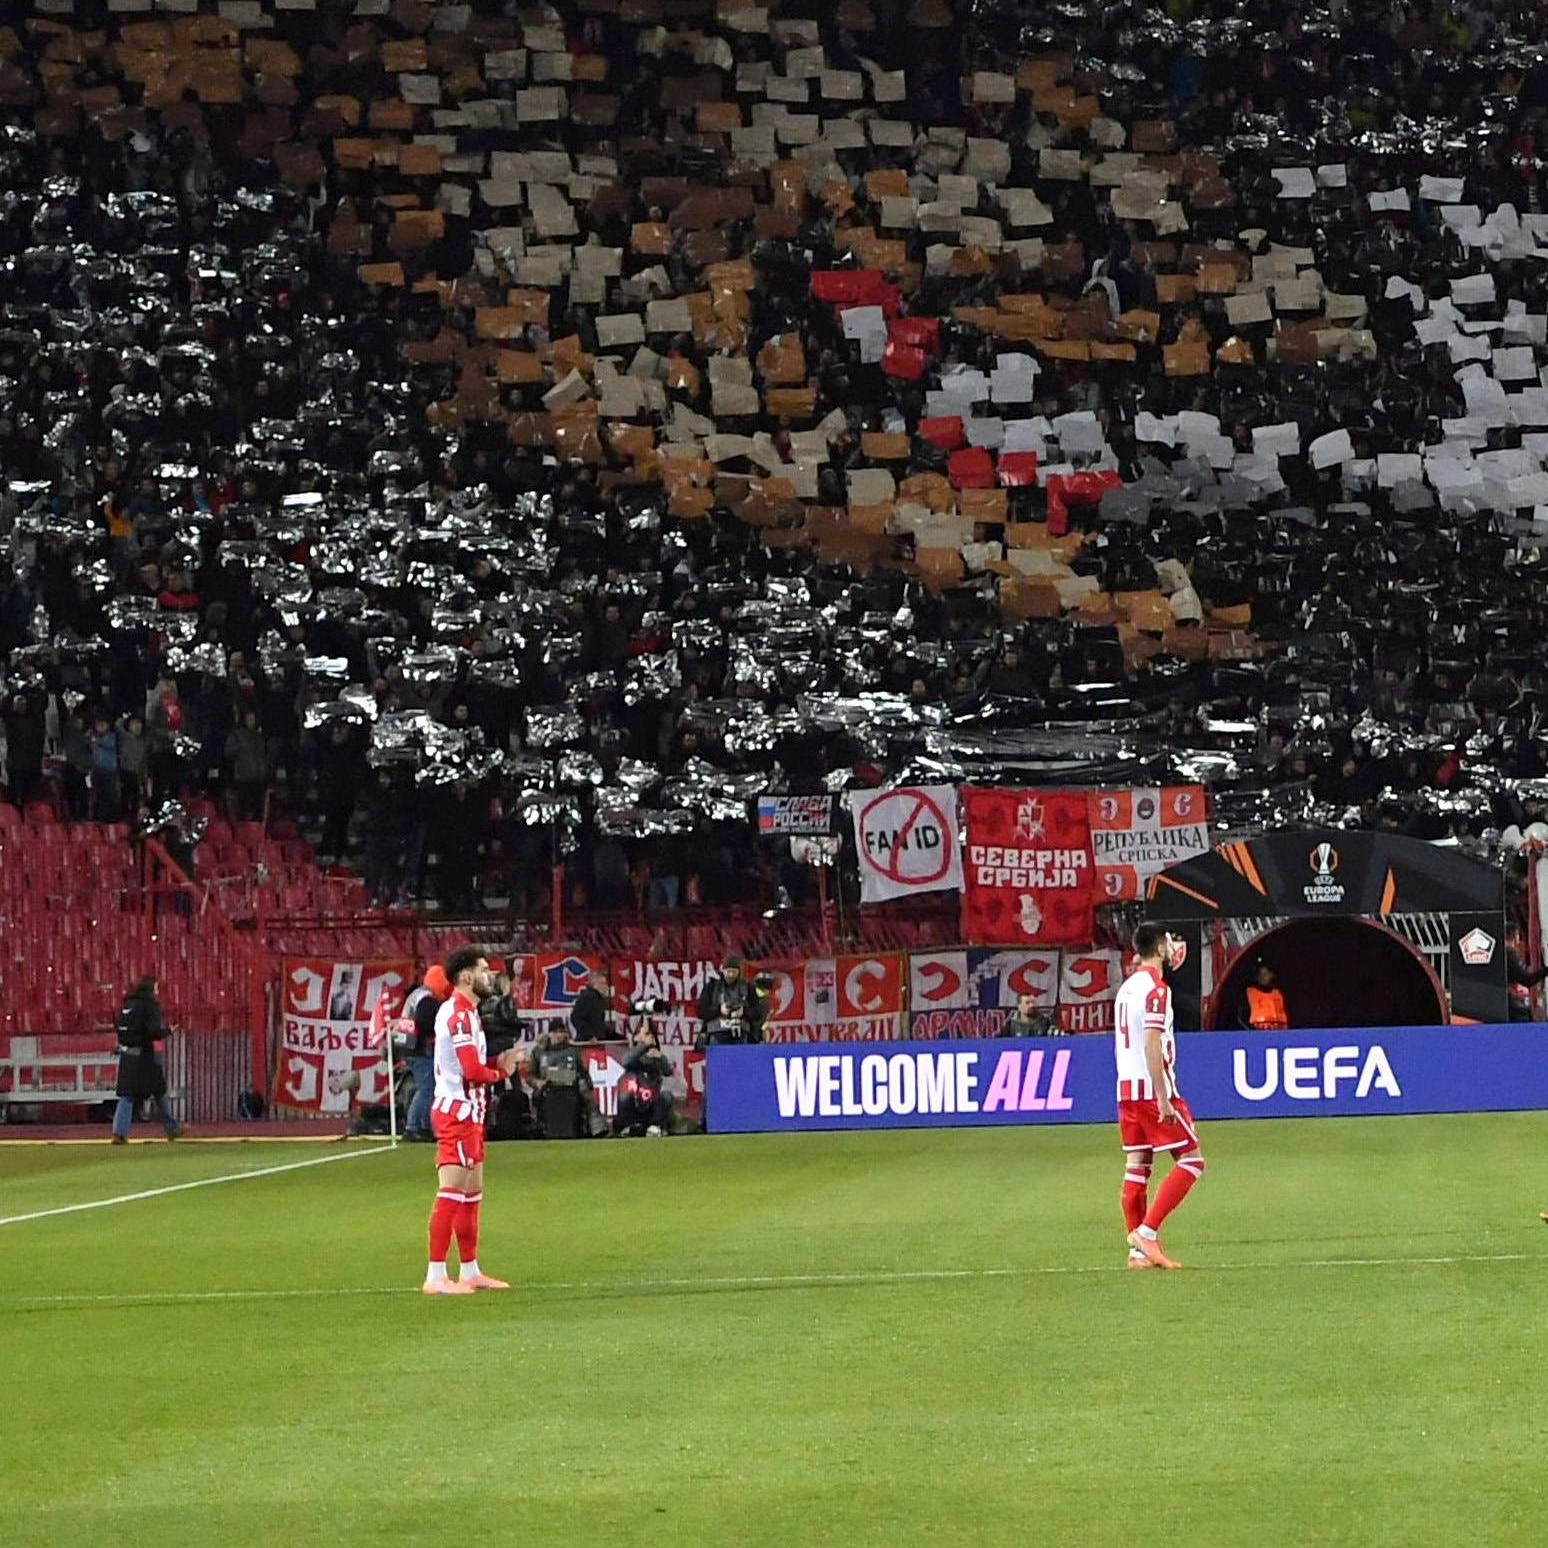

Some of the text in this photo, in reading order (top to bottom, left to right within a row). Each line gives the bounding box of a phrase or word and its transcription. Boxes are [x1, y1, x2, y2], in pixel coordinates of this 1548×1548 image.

[773, 812, 831, 828] РОССИИ
[865, 825, 940, 854] FAN ID
[1094, 826, 1206, 852] РЕПУБЛИКА
[970, 845, 1088, 869] СЕВЕРНА
[1119, 848, 1178, 862] СРПСКА
[977, 866, 1078, 888] СРБИЈА
[1303, 885, 1345, 895] EUROPA
[1306, 894, 1342, 903] LEAGUE
[773, 1049, 1074, 1118] WELCOME ALL
[1233, 1045, 1402, 1100] UEFA
